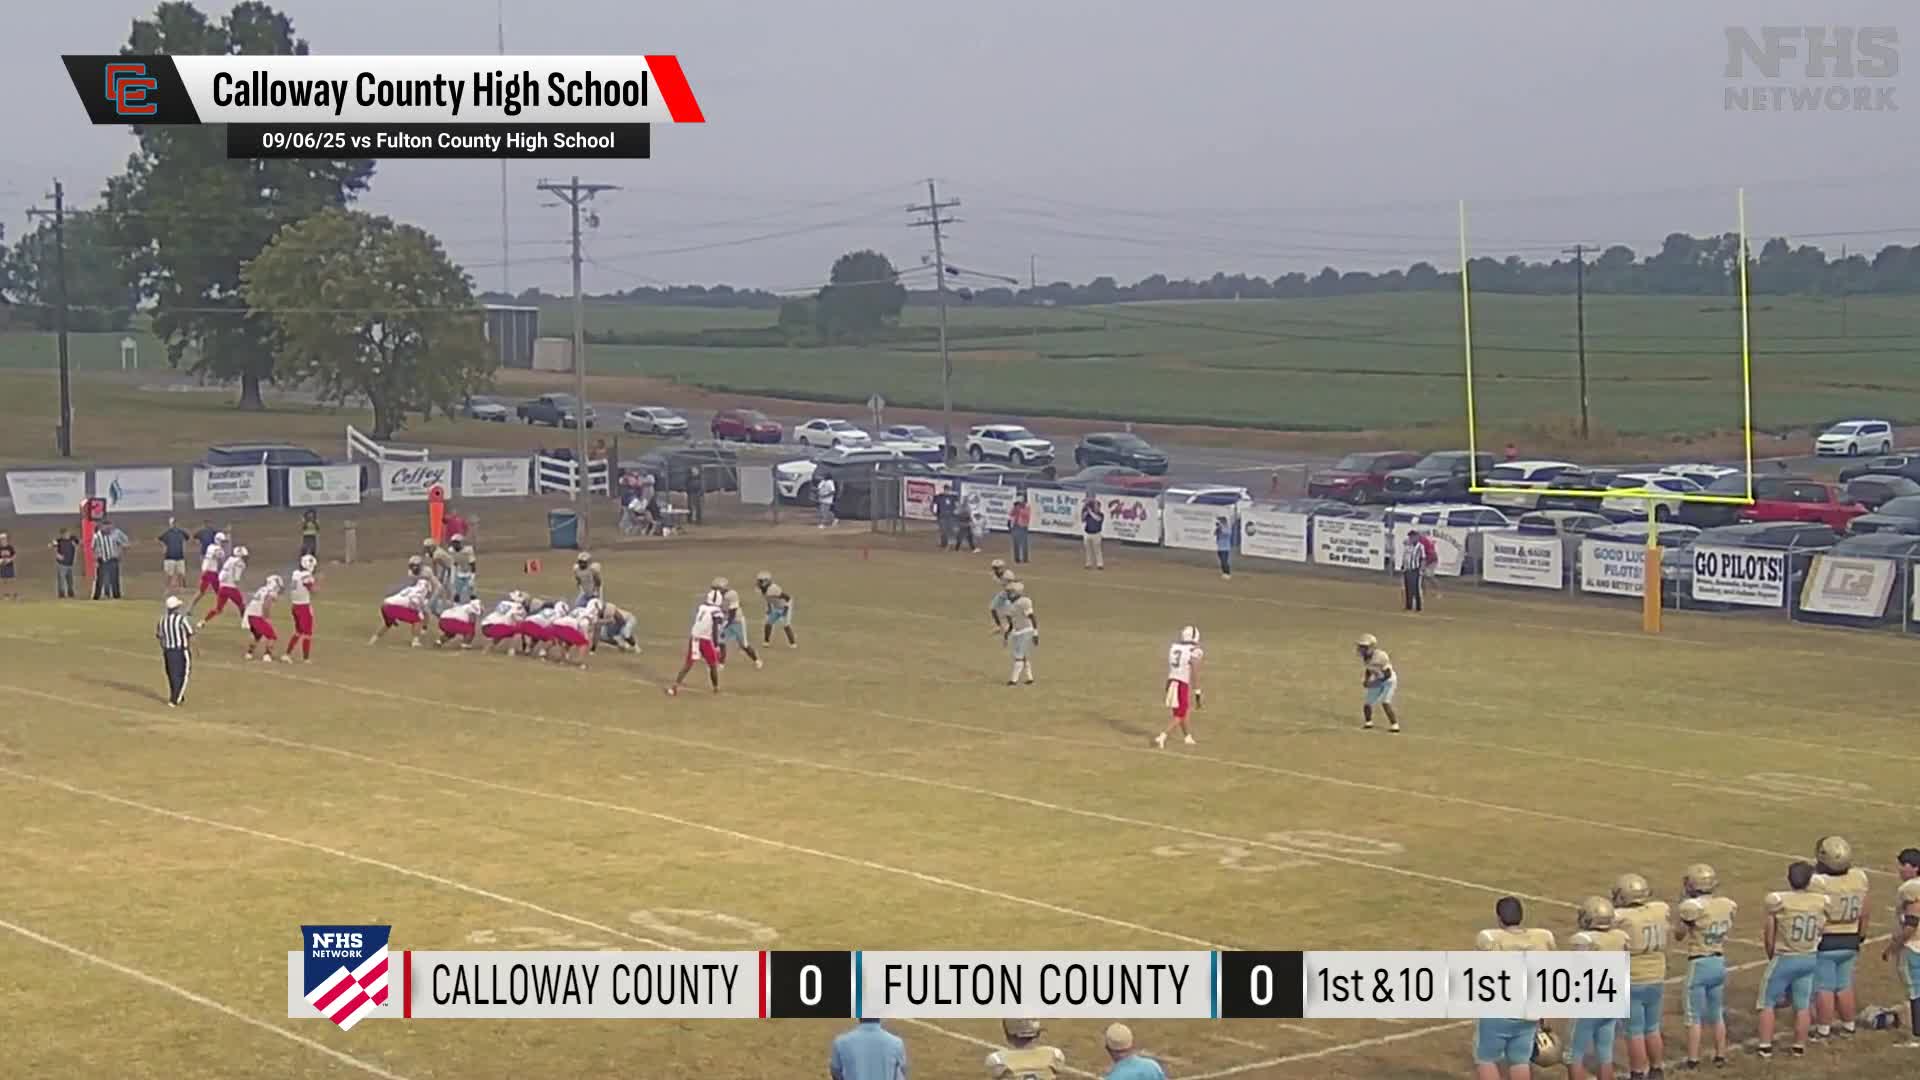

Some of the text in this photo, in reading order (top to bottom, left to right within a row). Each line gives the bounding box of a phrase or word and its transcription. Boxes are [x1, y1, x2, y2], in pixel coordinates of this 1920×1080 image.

[1593, 547, 1623, 562] GOOD
[1695, 551, 1782, 583] GO PILOTS!
[1171, 649, 1182, 669] 3
[1792, 915, 1818, 942] 60
